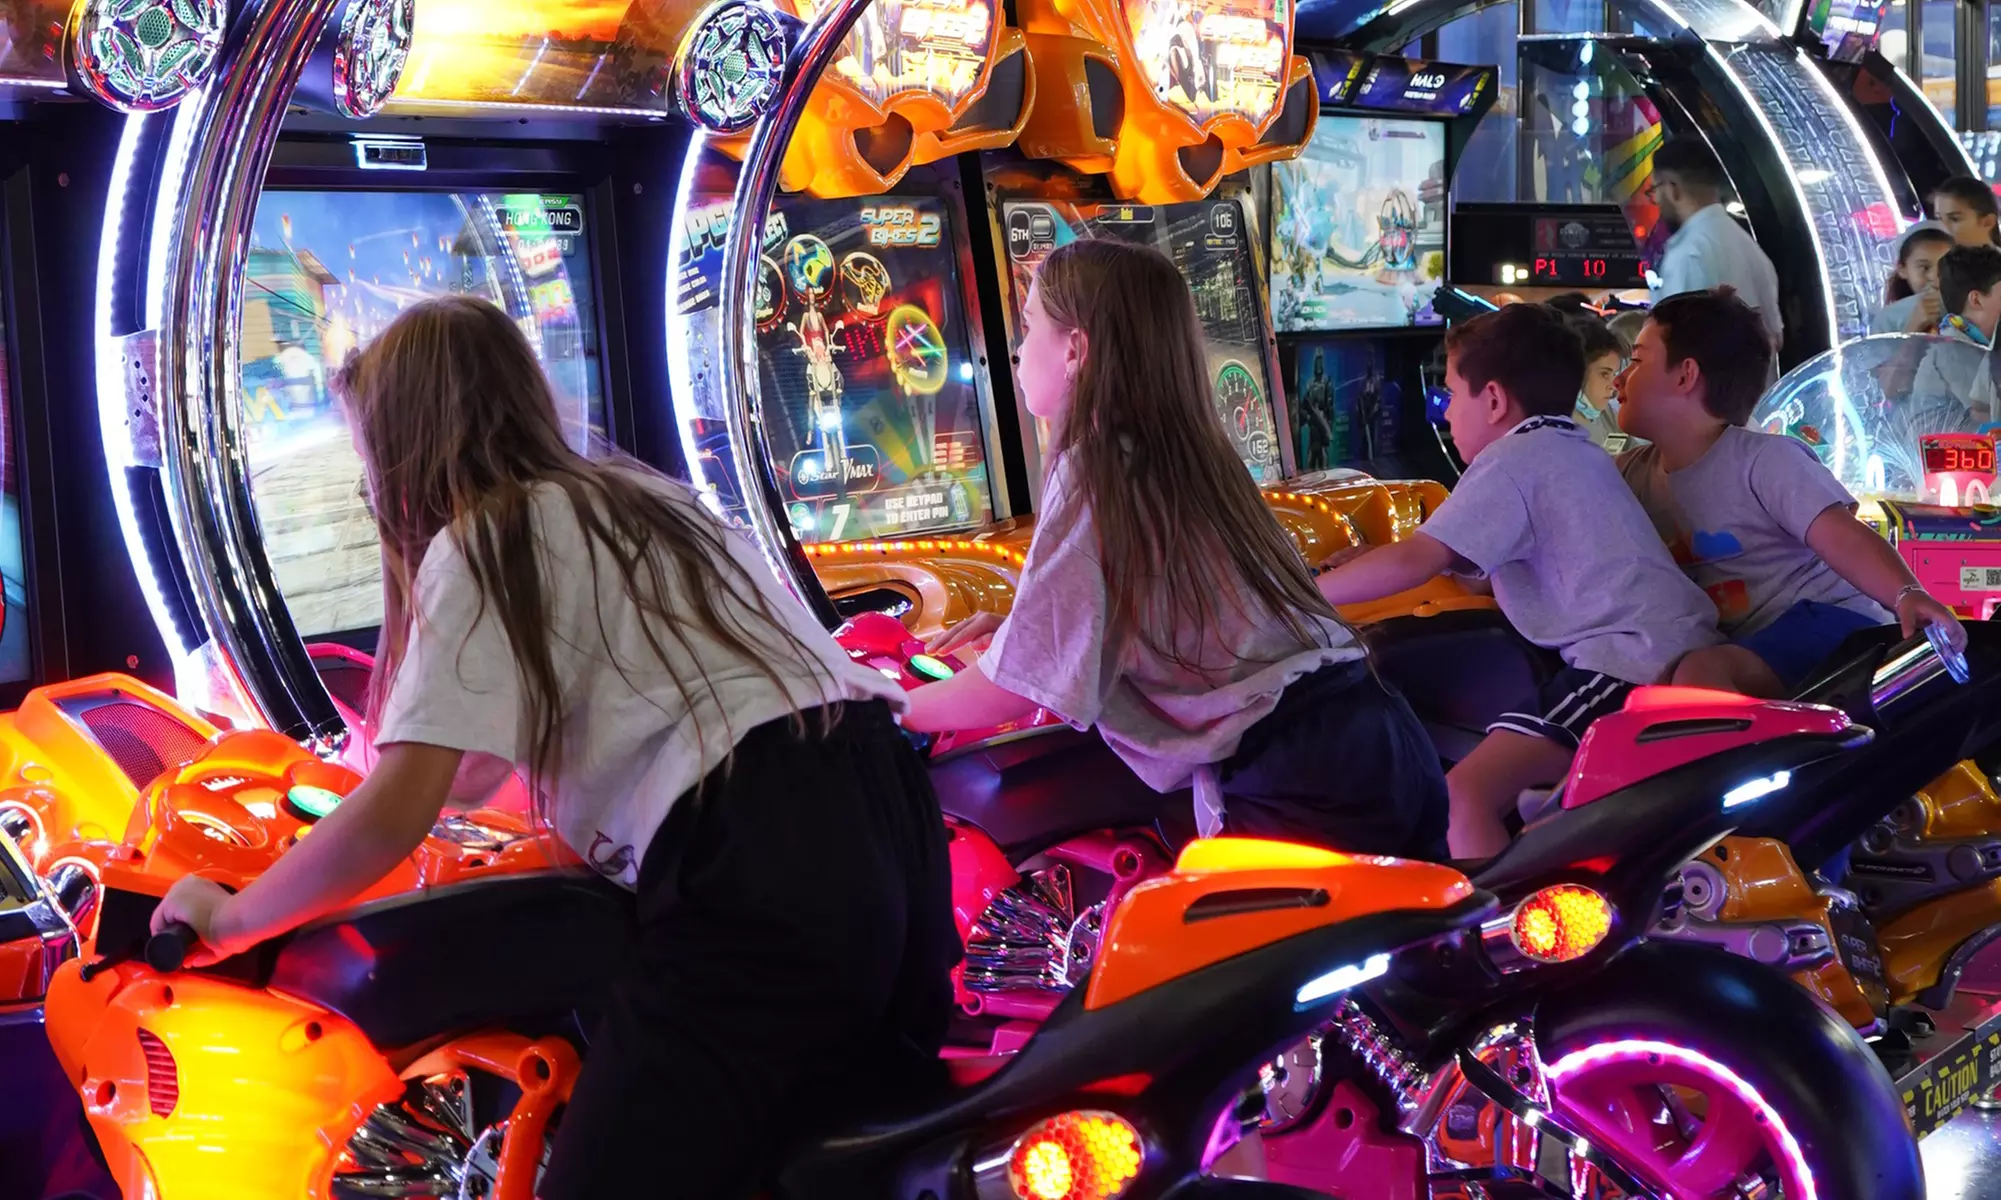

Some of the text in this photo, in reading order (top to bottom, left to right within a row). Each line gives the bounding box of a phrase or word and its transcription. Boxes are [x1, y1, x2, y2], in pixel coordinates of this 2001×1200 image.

[1409, 73, 1446, 88] HALO
[505, 211, 572, 226] HONG KONG
[860, 207, 916, 226] SUPER
[1215, 213, 1233, 229] 106
[871, 213, 941, 246] BIKES 2
[1011, 227, 1029, 242] 6TH
[1535, 258, 1558, 276] P1
[1583, 259, 1606, 277] 10
[1945, 448, 1992, 469] 360
[885, 492, 944, 510] USE KEYPAD
[828, 503, 850, 541] 7
[886, 505, 949, 525] TO ENTER PIN
[1925, 1058, 1978, 1118] CAUTION
